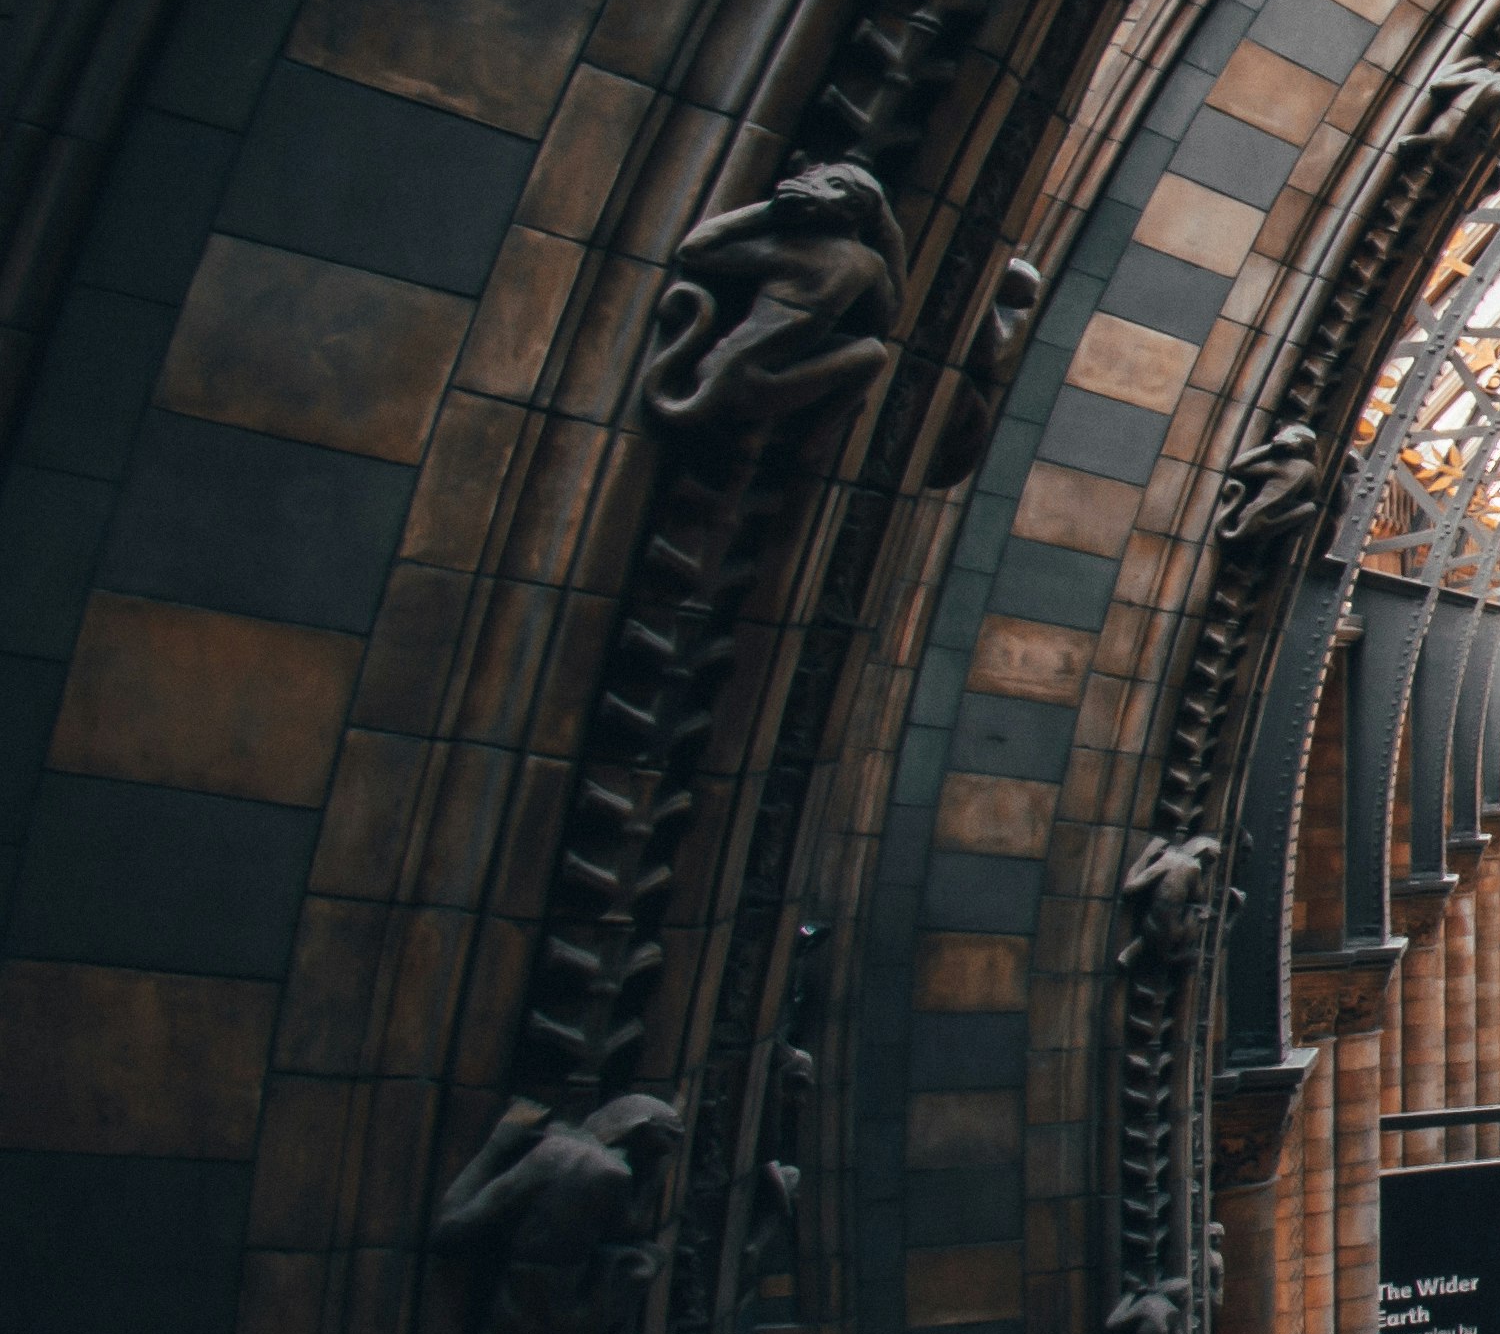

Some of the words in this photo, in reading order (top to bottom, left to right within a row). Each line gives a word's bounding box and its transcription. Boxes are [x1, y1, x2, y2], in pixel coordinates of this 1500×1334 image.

[1378, 1281, 1412, 1301] The
[1416, 1274, 1479, 1297] Wider
[1378, 1305, 1430, 1328] Earth
